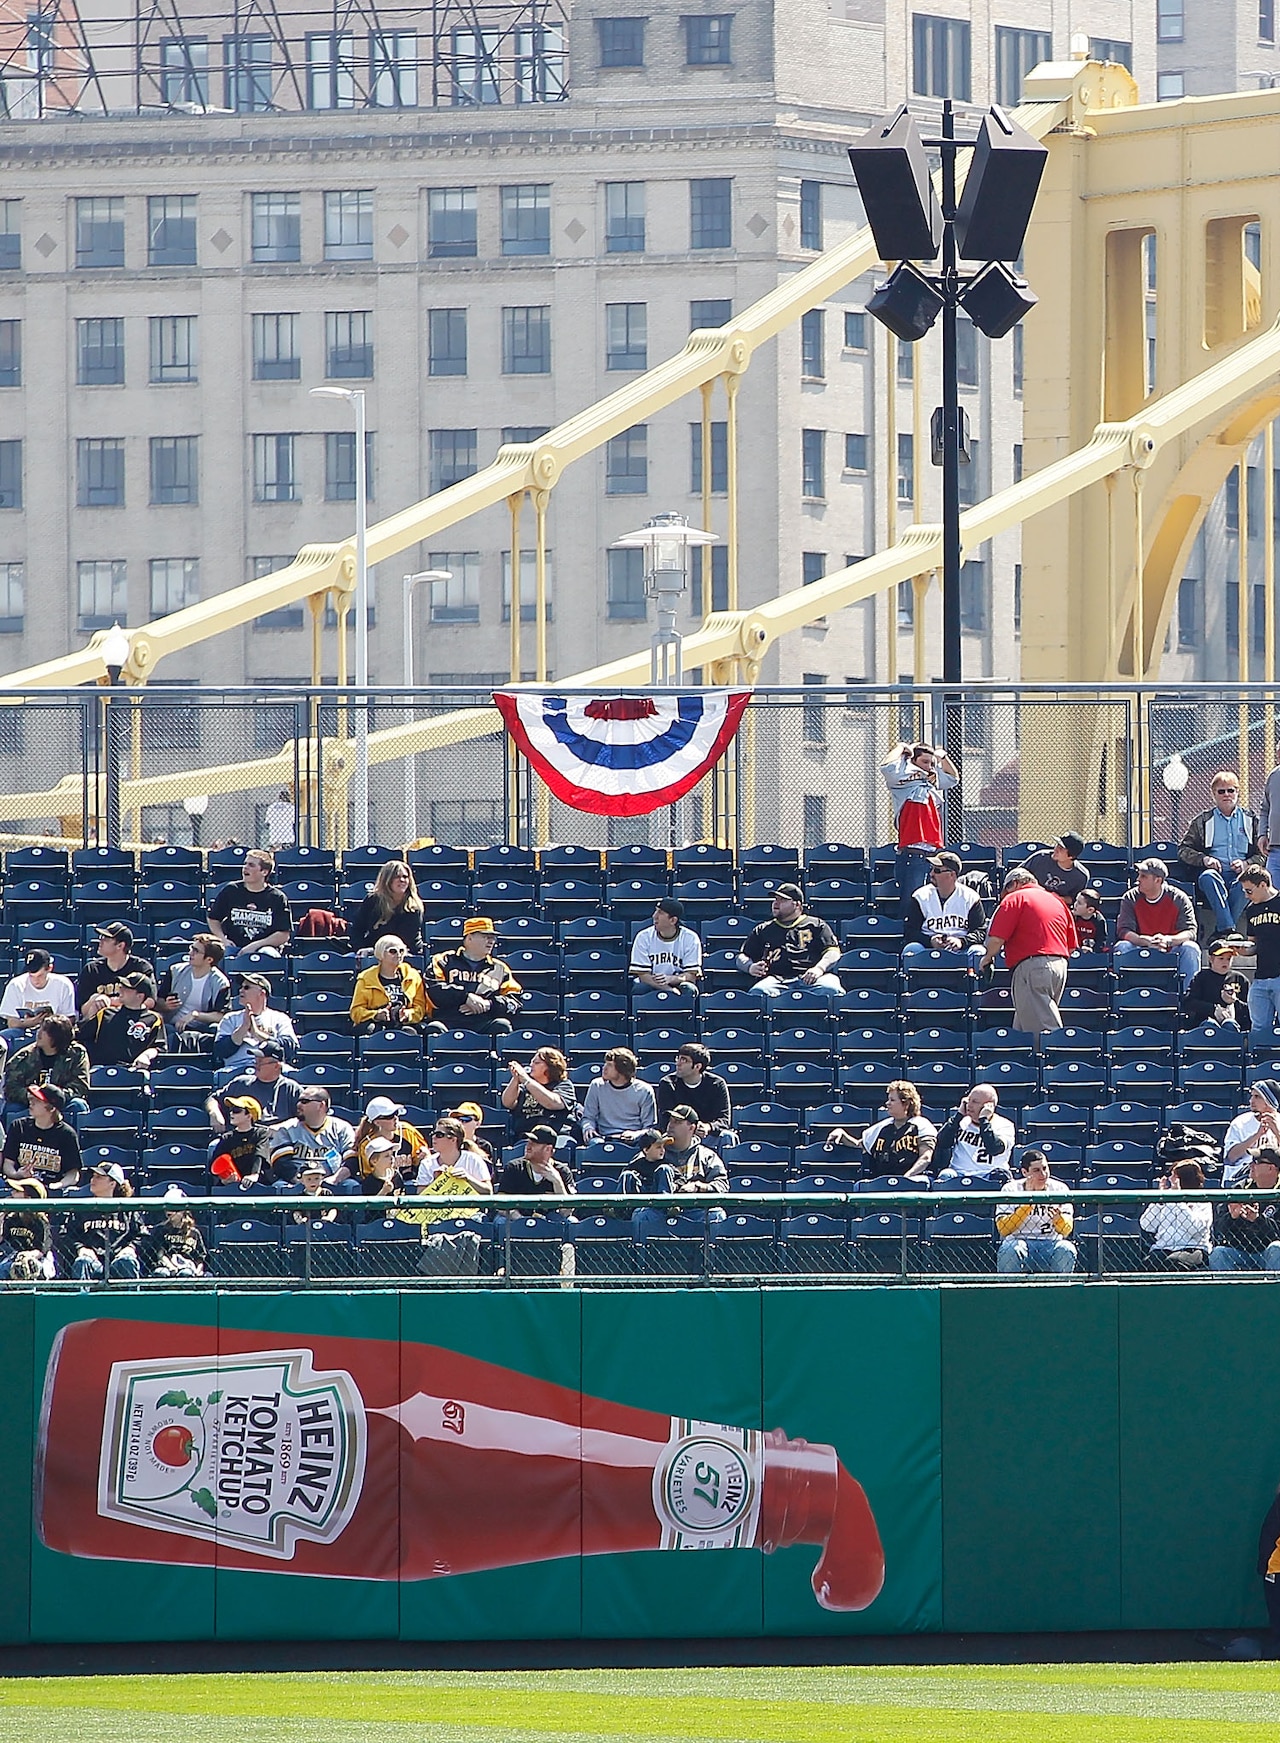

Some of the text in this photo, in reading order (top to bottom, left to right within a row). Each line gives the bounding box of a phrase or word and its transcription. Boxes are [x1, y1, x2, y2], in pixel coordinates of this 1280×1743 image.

[799, 929, 814, 948] P
[27, 954, 34, 965] P
[976, 1148, 993, 1164] 21
[133, 1403, 144, 1418] NET
[442, 1400, 464, 1434] 57
[132, 1420, 142, 1432] WT
[147, 1418, 174, 1437] GROWN
[130, 1434, 140, 1443] 14
[144, 1439, 153, 1456] NOT
[129, 1445, 140, 1456] OZ
[217, 1396, 249, 1509] KETCHUP
[242, 1392, 280, 1515] TOMATO
[280, 1439, 292, 1469] 1869
[286, 1399, 334, 1513] HEINZ
[672, 1454, 693, 1514] VARIETIES
[694, 1461, 720, 1509] 57
[720, 1461, 742, 1514] HEINZ
